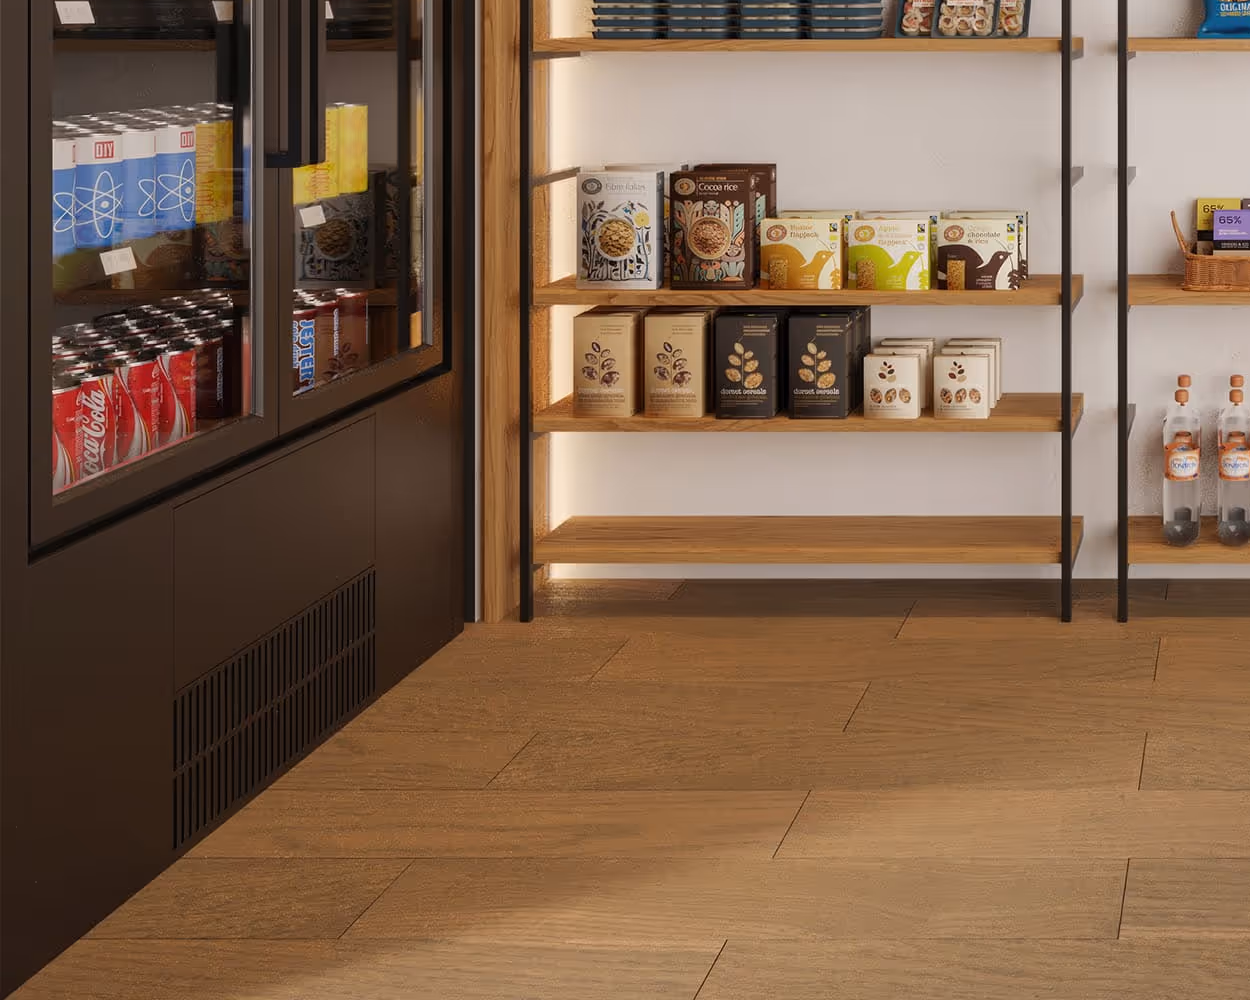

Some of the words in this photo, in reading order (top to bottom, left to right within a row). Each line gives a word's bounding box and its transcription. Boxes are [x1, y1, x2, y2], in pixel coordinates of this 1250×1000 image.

[95, 143, 113, 157] DIY
[698, 183, 722, 192] Cocoa
[723, 182, 738, 191] rice
[1218, 215, 1242, 224] 65%
